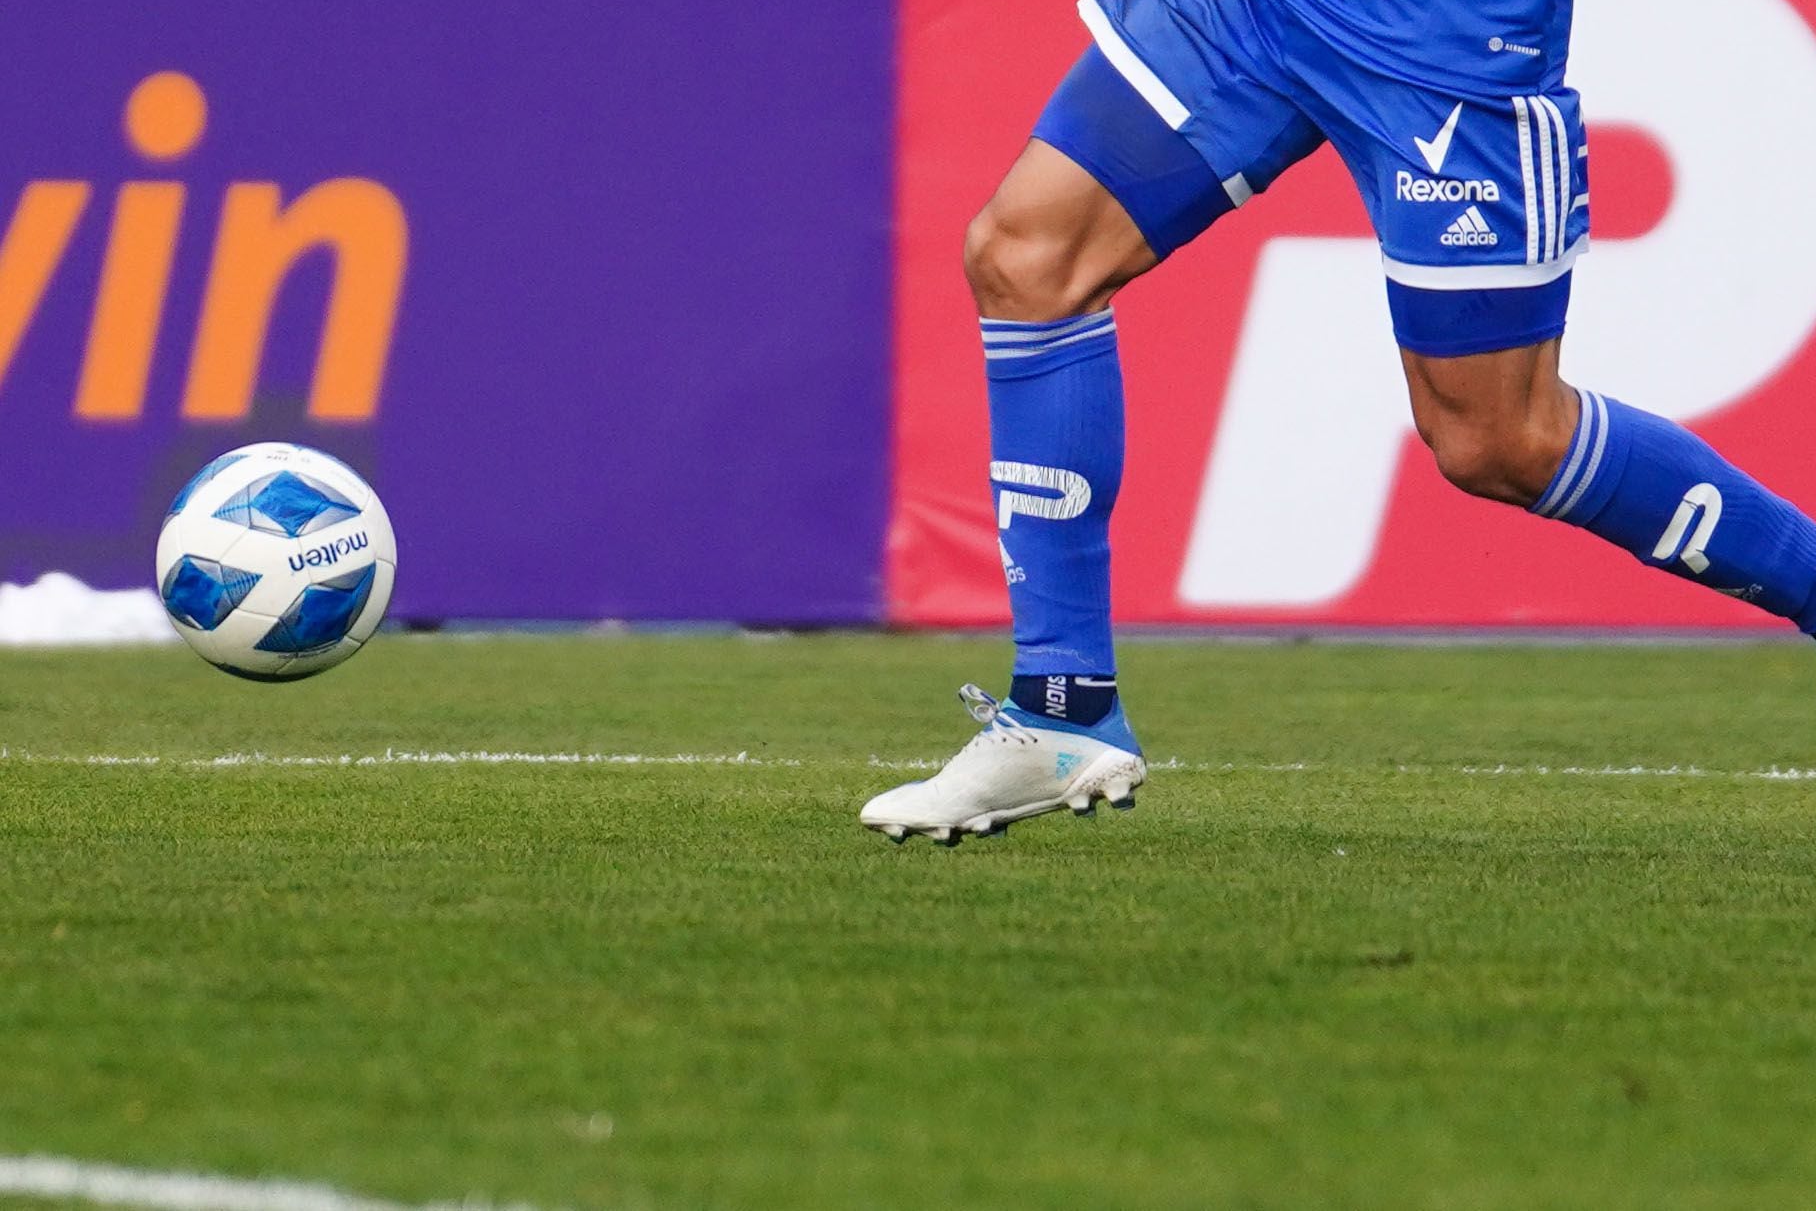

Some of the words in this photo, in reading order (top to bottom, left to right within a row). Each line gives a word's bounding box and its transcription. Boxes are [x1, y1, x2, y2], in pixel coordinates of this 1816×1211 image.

[1396, 170, 1500, 203] Rexona
[1440, 228, 1498, 247] adidas
[288, 530, 369, 573] molten
